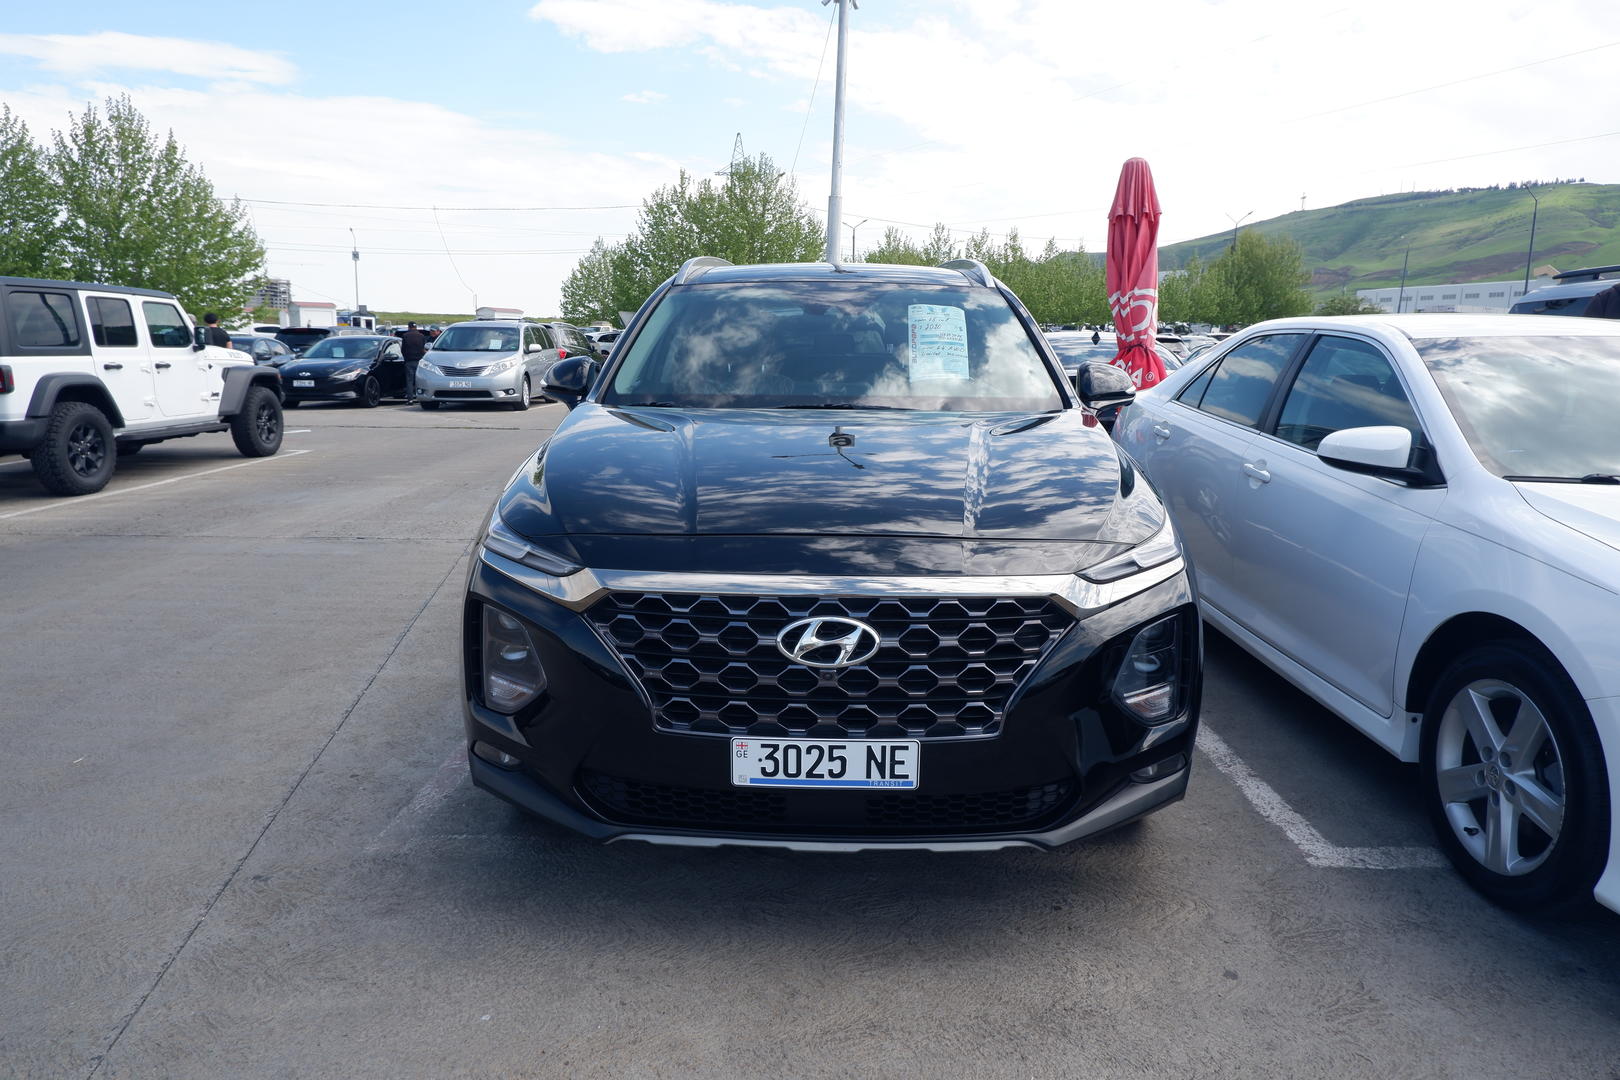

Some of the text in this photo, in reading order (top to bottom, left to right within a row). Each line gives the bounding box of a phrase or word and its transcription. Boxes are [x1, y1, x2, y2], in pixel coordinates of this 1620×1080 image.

[736, 750, 748, 758] GE
[760, 743, 910, 780] 3025 NE
